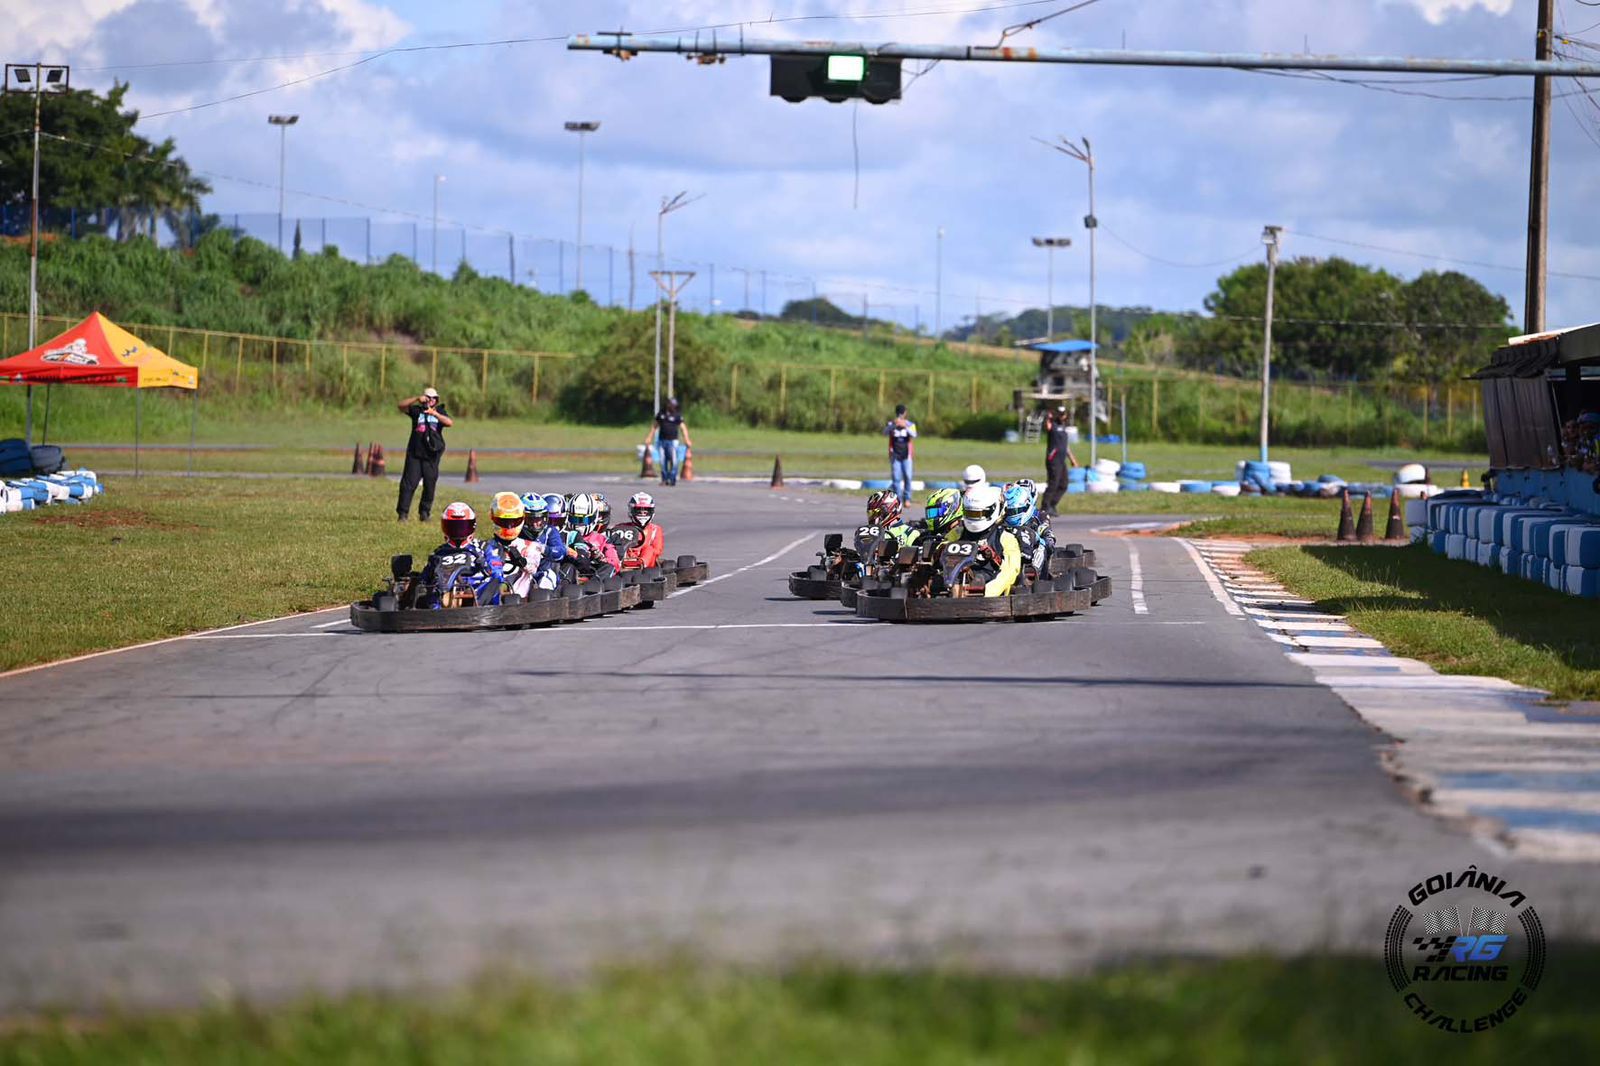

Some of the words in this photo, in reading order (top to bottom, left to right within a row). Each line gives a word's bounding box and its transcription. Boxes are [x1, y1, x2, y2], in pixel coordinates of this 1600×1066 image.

[859, 526, 880, 536] 26
[947, 543, 972, 555] 03
[441, 553, 467, 565] 32
